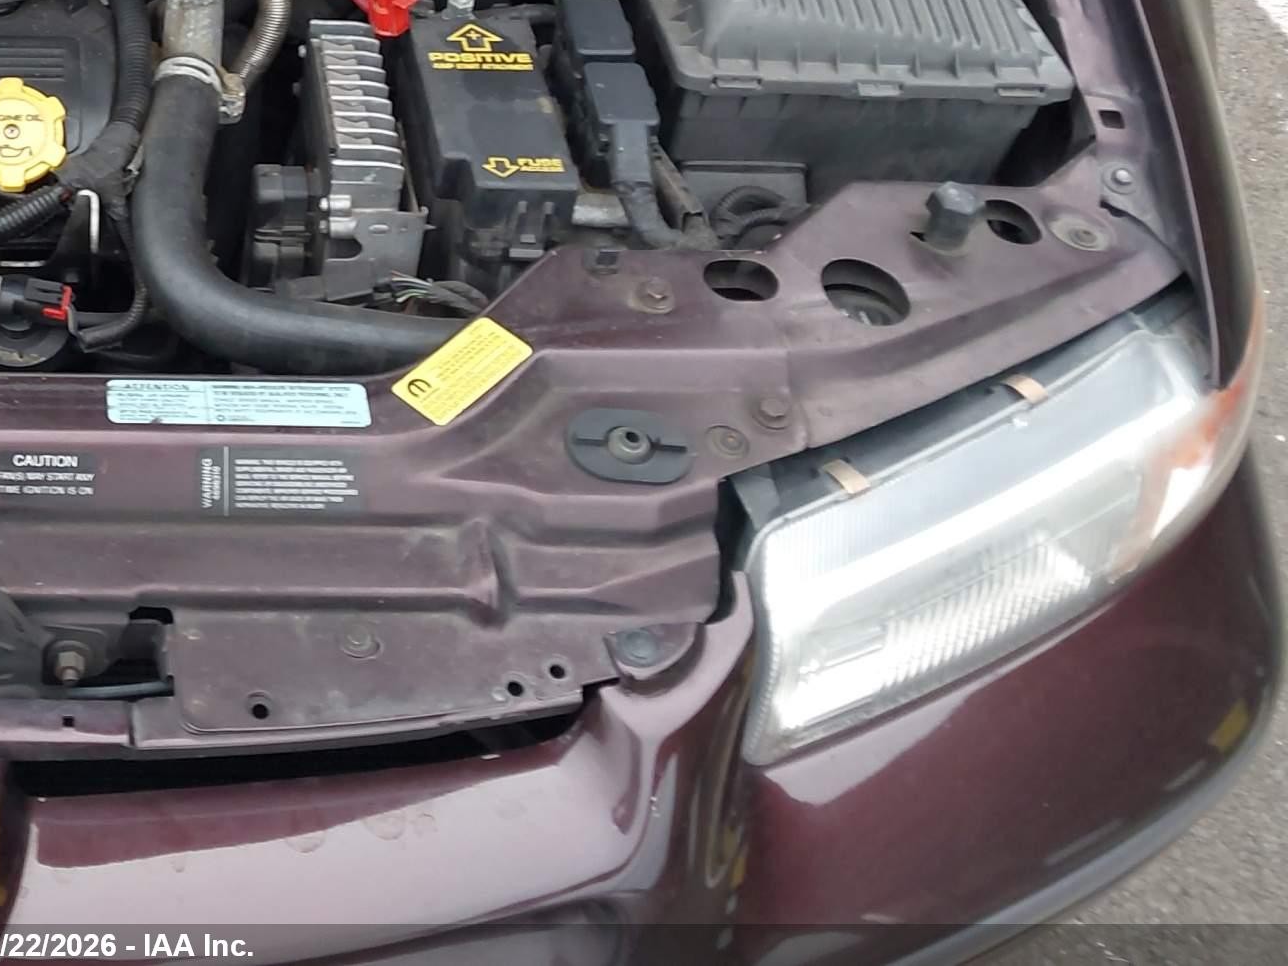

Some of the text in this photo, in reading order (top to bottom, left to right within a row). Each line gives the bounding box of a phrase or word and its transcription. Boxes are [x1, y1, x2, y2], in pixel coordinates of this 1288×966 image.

[427, 52, 533, 63] POSITIVE
[24, 114, 45, 122] OIL
[516, 157, 562, 167] FUSE
[12, 455, 78, 467] CAUTION
[201, 458, 213, 509] WARNING
[66, 486, 77, 495] IS
[78, 486, 95, 495] ON
